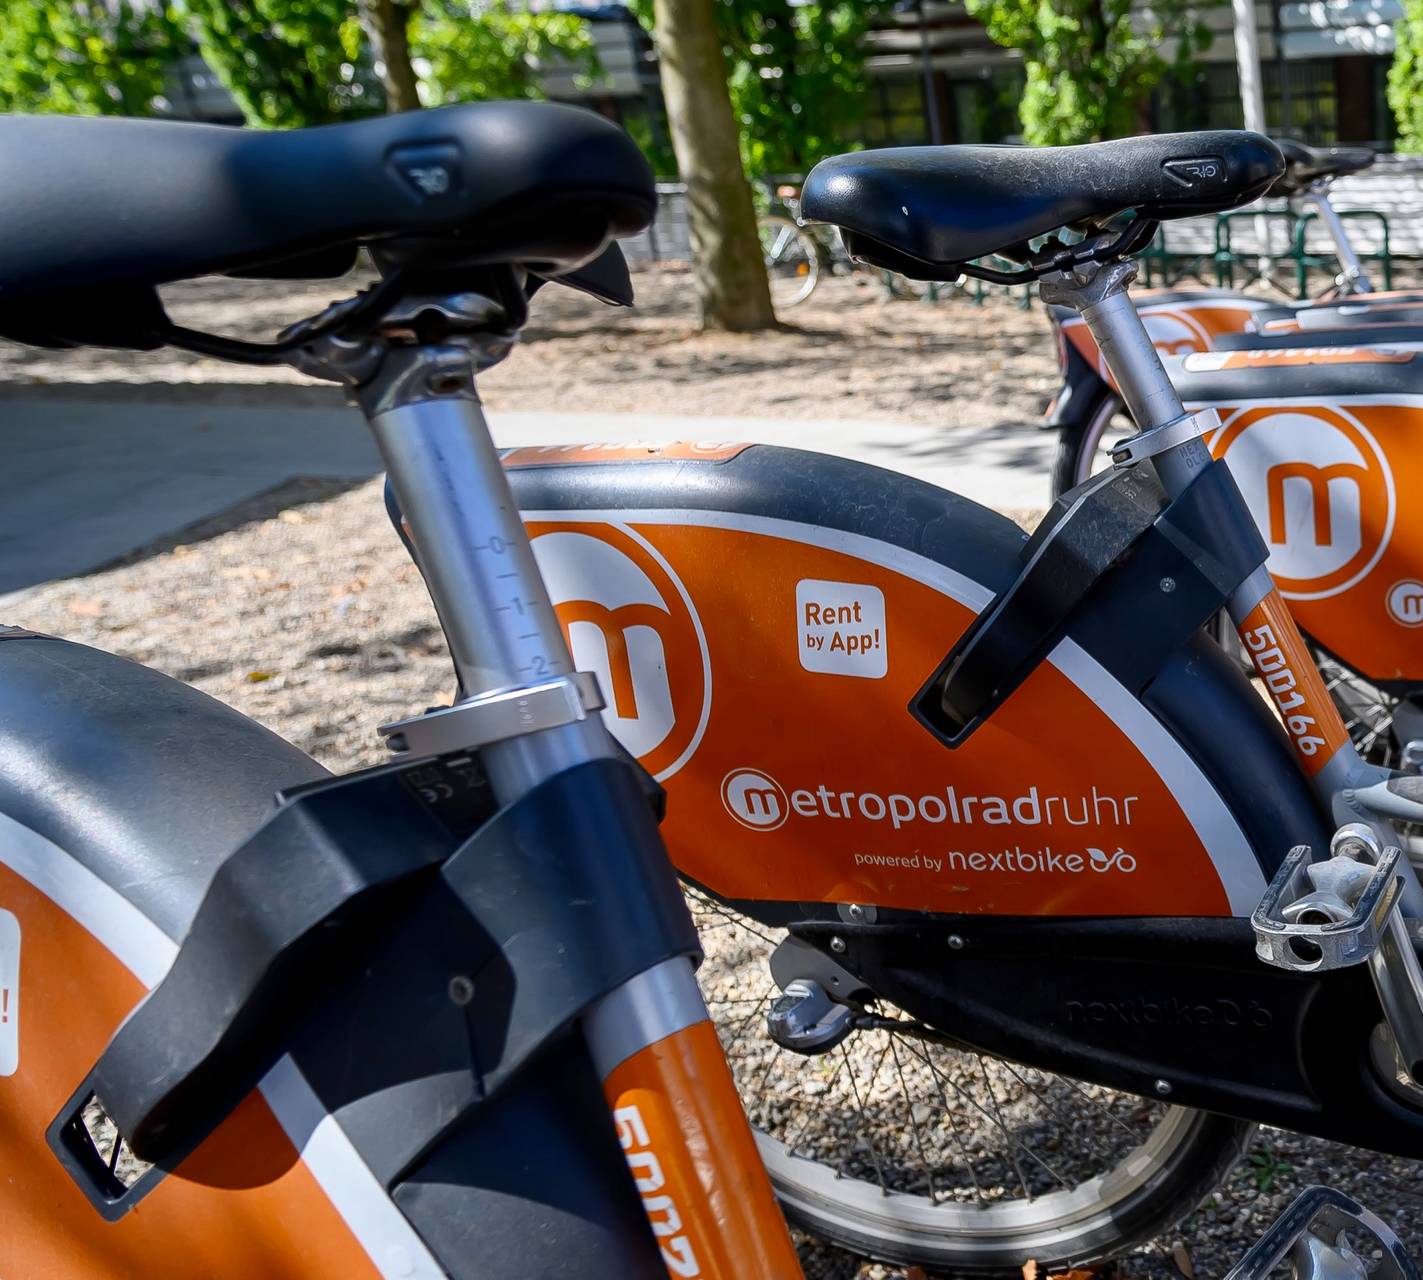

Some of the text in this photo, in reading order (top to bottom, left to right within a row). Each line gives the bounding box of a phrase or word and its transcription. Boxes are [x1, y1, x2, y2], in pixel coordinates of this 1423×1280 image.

[804, 601, 862, 627] Rent
[806, 628, 880, 656] by App!
[1244, 624, 1326, 756] 500166
[720, 767, 1139, 832] metropolradruhr
[854, 846, 1085, 873] powered by nextbike
